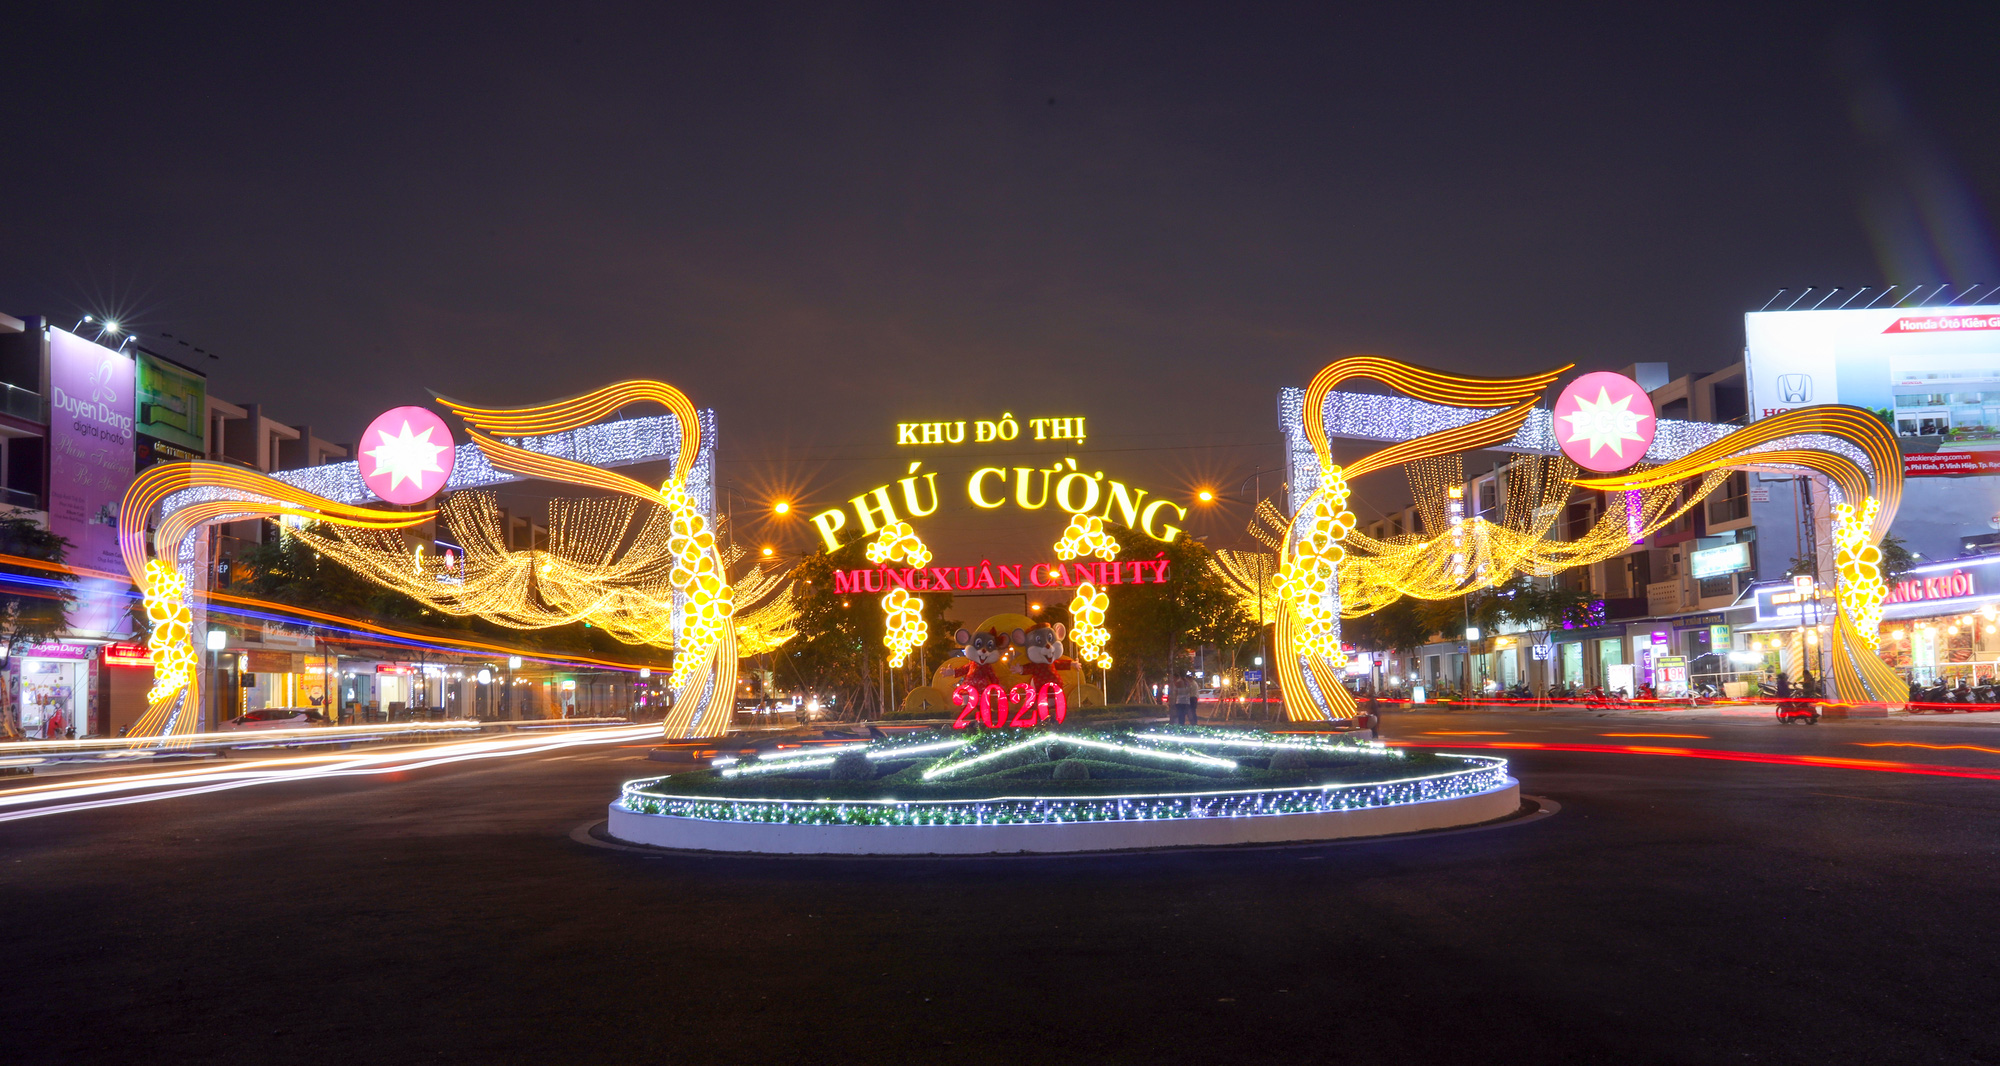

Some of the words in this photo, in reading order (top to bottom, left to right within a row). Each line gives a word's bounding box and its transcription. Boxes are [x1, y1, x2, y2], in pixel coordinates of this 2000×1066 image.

[1900, 319, 1938, 330] Honda
[1939, 317, 1960, 329] Ôtô
[1961, 317, 1988, 328] Kiên
[73, 420, 99, 437] digital
[100, 429, 125, 446] photo
[98, 402, 132, 439] Dáng
[896, 421, 966, 445] KHU
[973, 412, 1020, 443] ĐÔ
[1028, 417, 1087, 446] THỊ
[808, 460, 939, 556] PHÚ
[967, 457, 1188, 543] CƯỜNG
[1029, 561, 1123, 588] CANH
[1126, 551, 1171, 585] TÝ
[1923, 569, 1974, 599] KHÔI
[1658, 667, 1686, 682] 119K
[952, 682, 1067, 729] 2020
